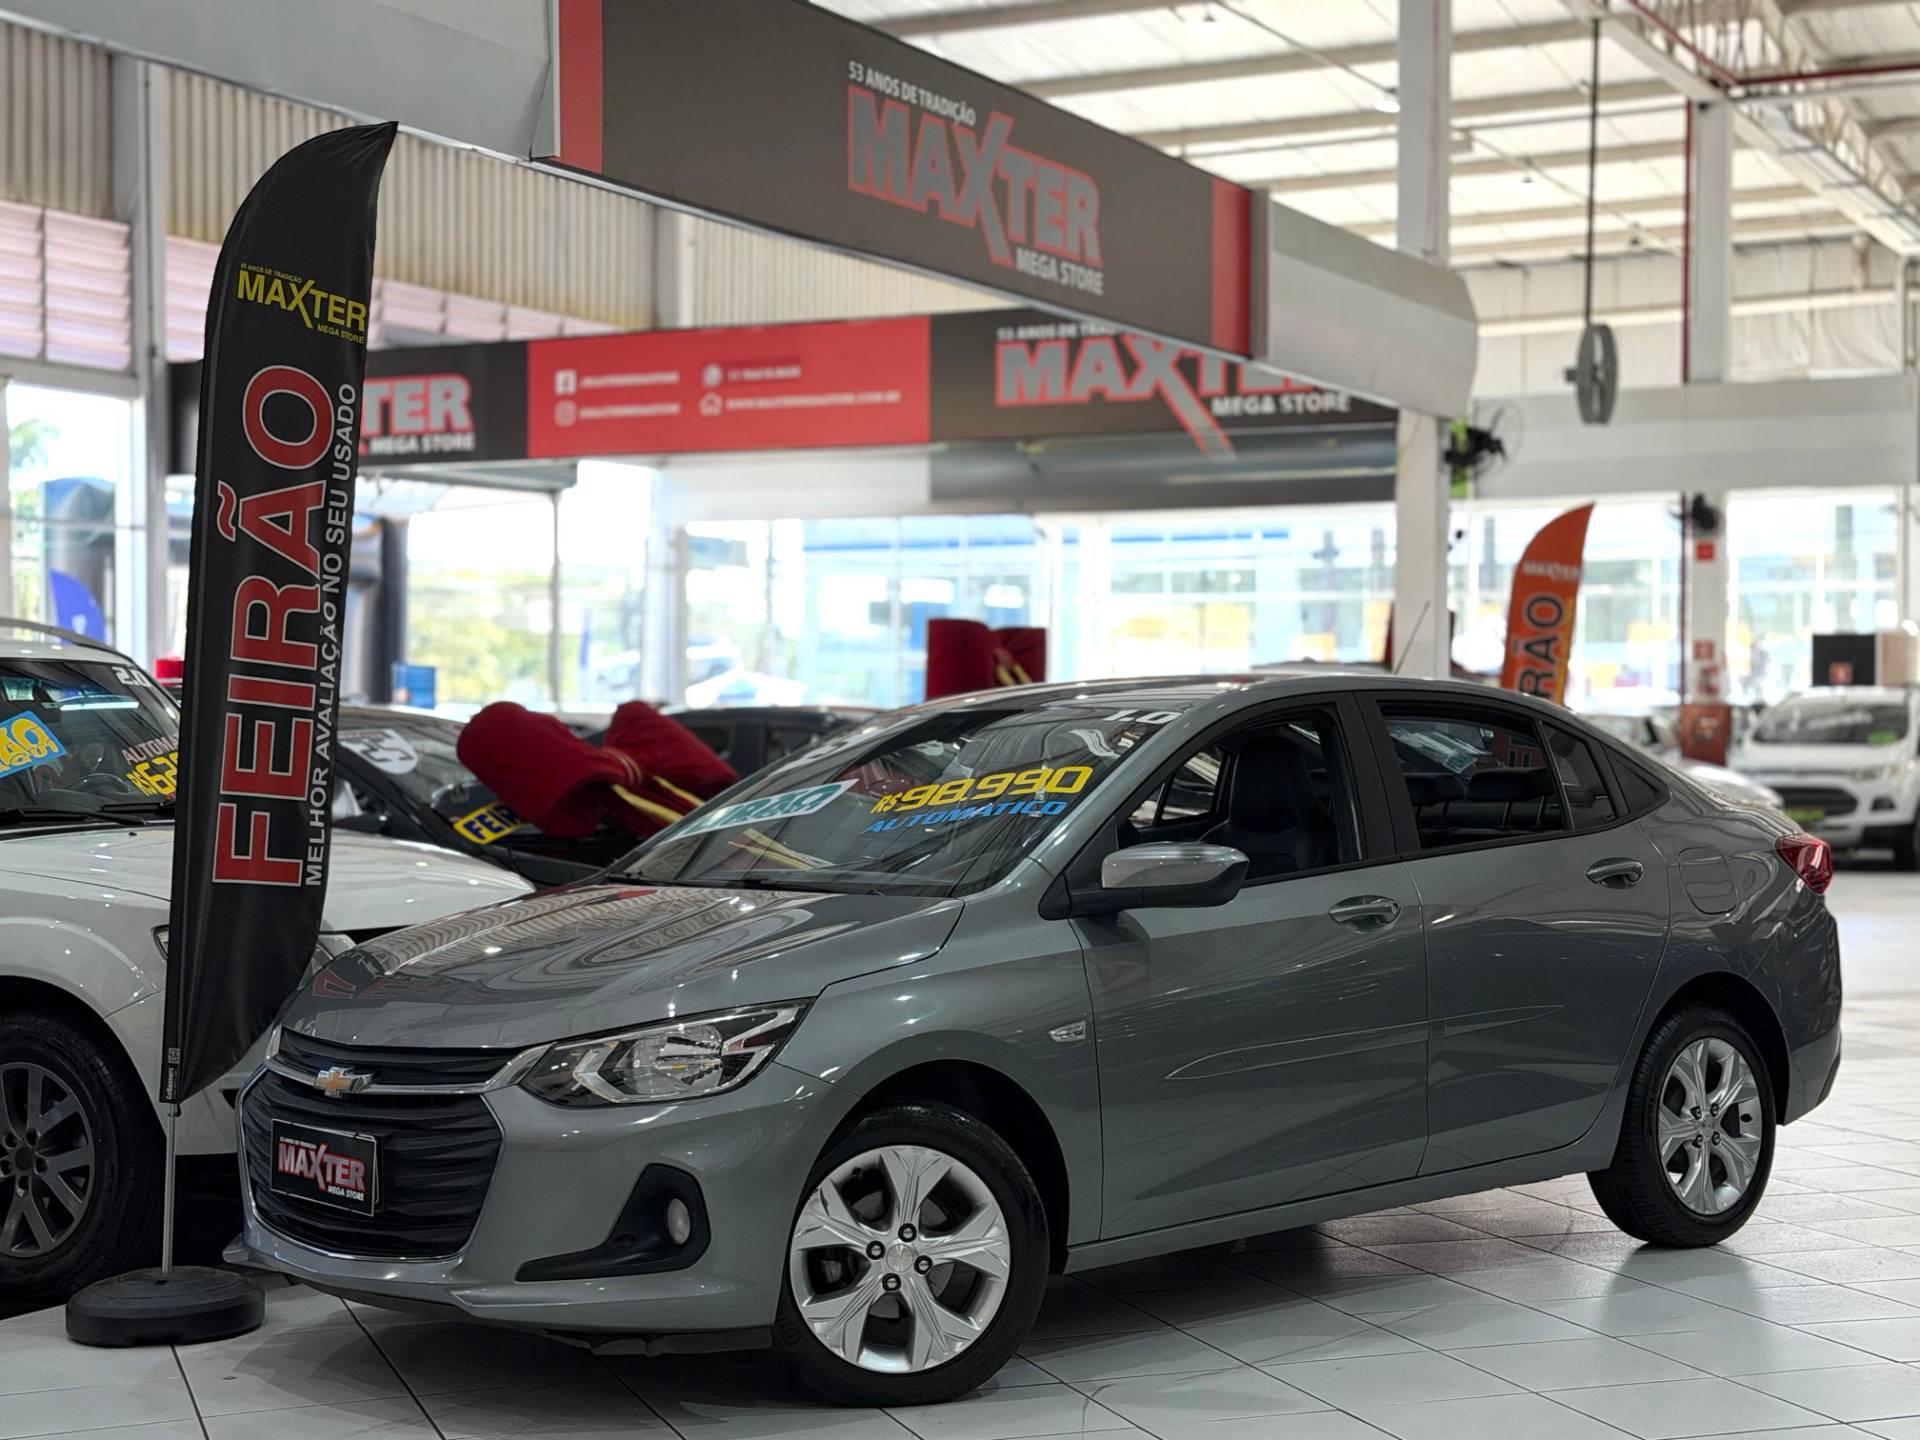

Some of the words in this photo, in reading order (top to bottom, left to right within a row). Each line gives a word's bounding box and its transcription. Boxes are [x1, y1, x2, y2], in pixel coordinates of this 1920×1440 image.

[848, 60, 864, 83] 53
[865, 67, 900, 98] ANOS
[901, 82, 918, 104] DE
[918, 87, 976, 126] TRADIÇÃO
[848, 84, 1104, 268] MAXTER
[1016, 246, 1059, 281] MEGA
[1060, 263, 1104, 296] STORE
[237, 269, 368, 332] MAXTER
[317, 323, 340, 338] MEGA
[340, 329, 365, 344] STORE
[1212, 396, 1275, 417] MEGA
[1279, 392, 1350, 414] STORE
[332, 383, 357, 481] USADO
[369, 435, 419, 455] MEGA
[325, 491, 348, 545] SEU
[321, 552, 344, 594] NO
[211, 365, 334, 887] FEIRÃO
[112, 667, 151, 687] 2.0
[315, 601, 340, 760] AVALIAÇÃO
[1102, 709, 1182, 724] 1.0
[305, 767, 329, 887] MELHOR
[278, 1141, 366, 1192] MAXTER
[327, 1185, 346, 1197] MEGA
[345, 1189, 365, 1202] STORE
